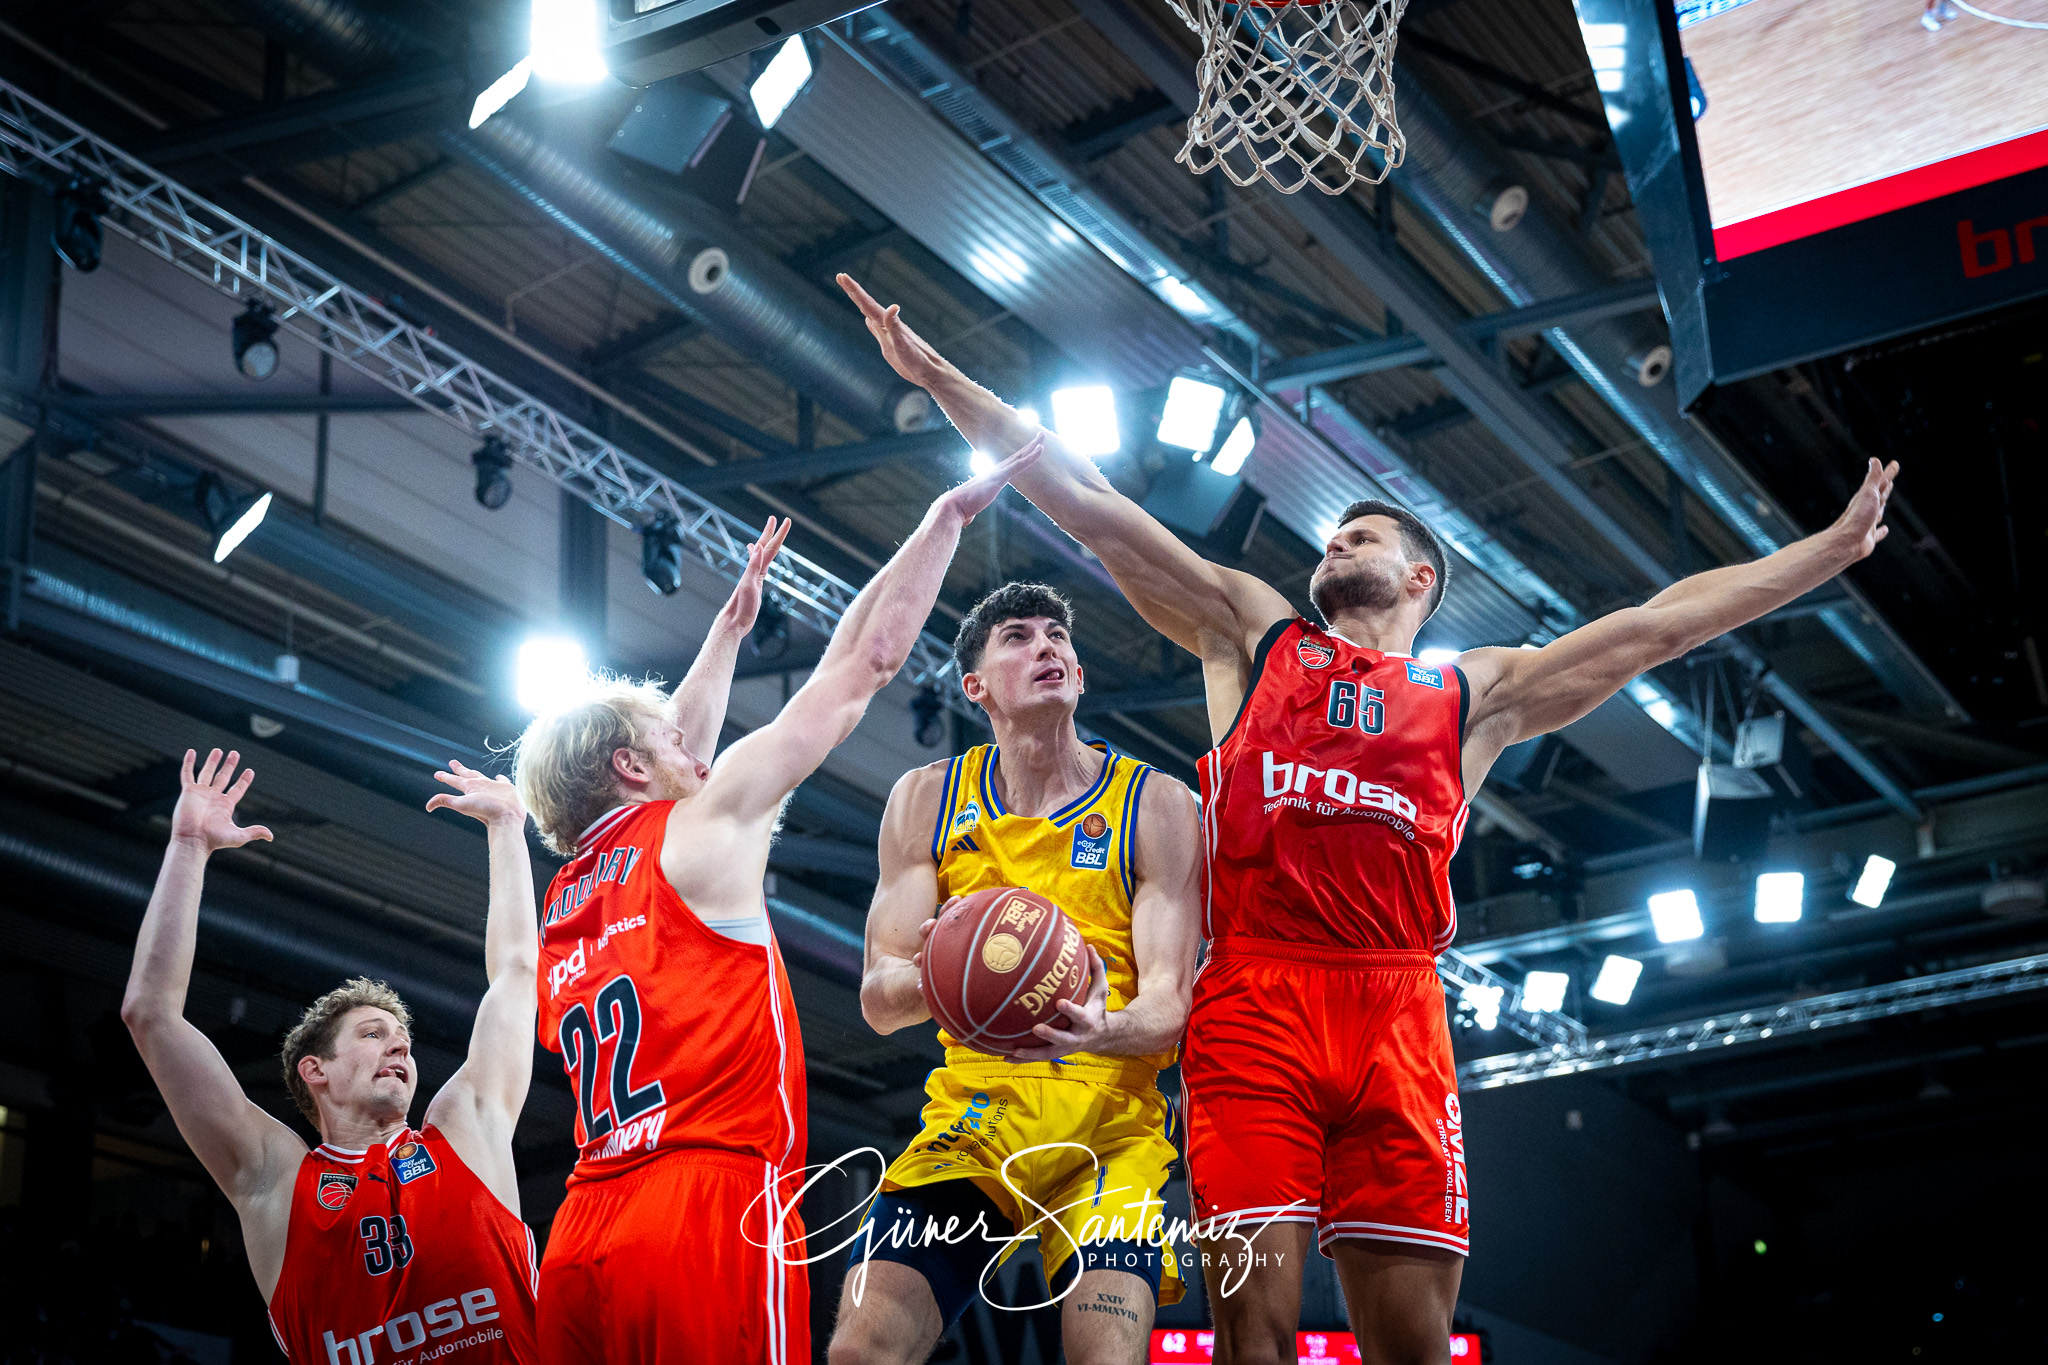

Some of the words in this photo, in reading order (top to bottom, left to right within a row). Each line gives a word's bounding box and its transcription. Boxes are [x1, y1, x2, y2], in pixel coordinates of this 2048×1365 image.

[1327, 680, 1385, 735] 65
[1263, 795, 1310, 815] Technik
[1315, 801, 1338, 817] für
[1075, 852, 1103, 865] BBL
[1001, 899, 1028, 925] BBL
[558, 974, 668, 1149] 22
[403, 1164, 430, 1180] BBL
[1435, 1118, 1450, 1157] STIRKAT
[1444, 1169, 1454, 1223] KOLLEGEN
[360, 1214, 414, 1276] 33
[1097, 1292, 1125, 1305] XXIV
[1077, 1303, 1138, 1322] VI-MMXVIII
[419, 1328, 504, 1364] Automobile
